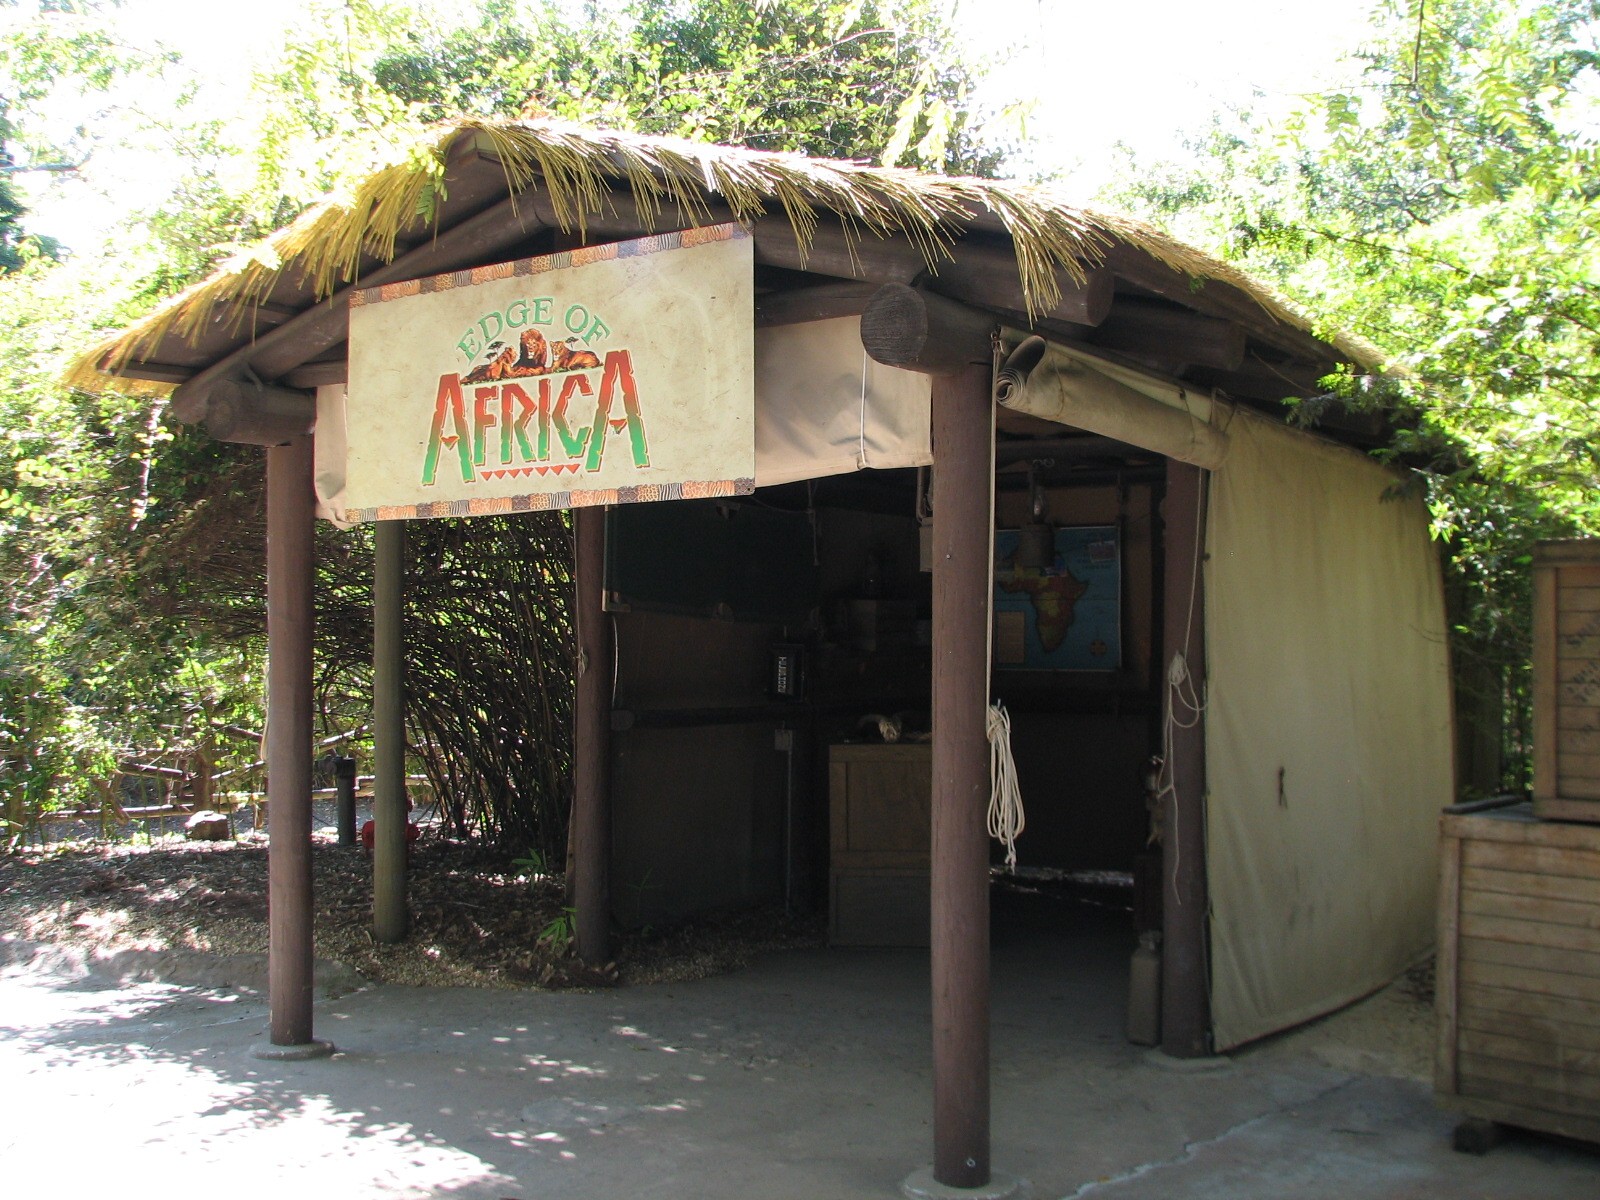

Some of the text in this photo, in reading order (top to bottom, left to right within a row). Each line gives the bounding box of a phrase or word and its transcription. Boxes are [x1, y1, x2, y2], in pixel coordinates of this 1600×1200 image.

[457, 297, 611, 362] EDGE OF
[422, 350, 650, 487] AFRICA
